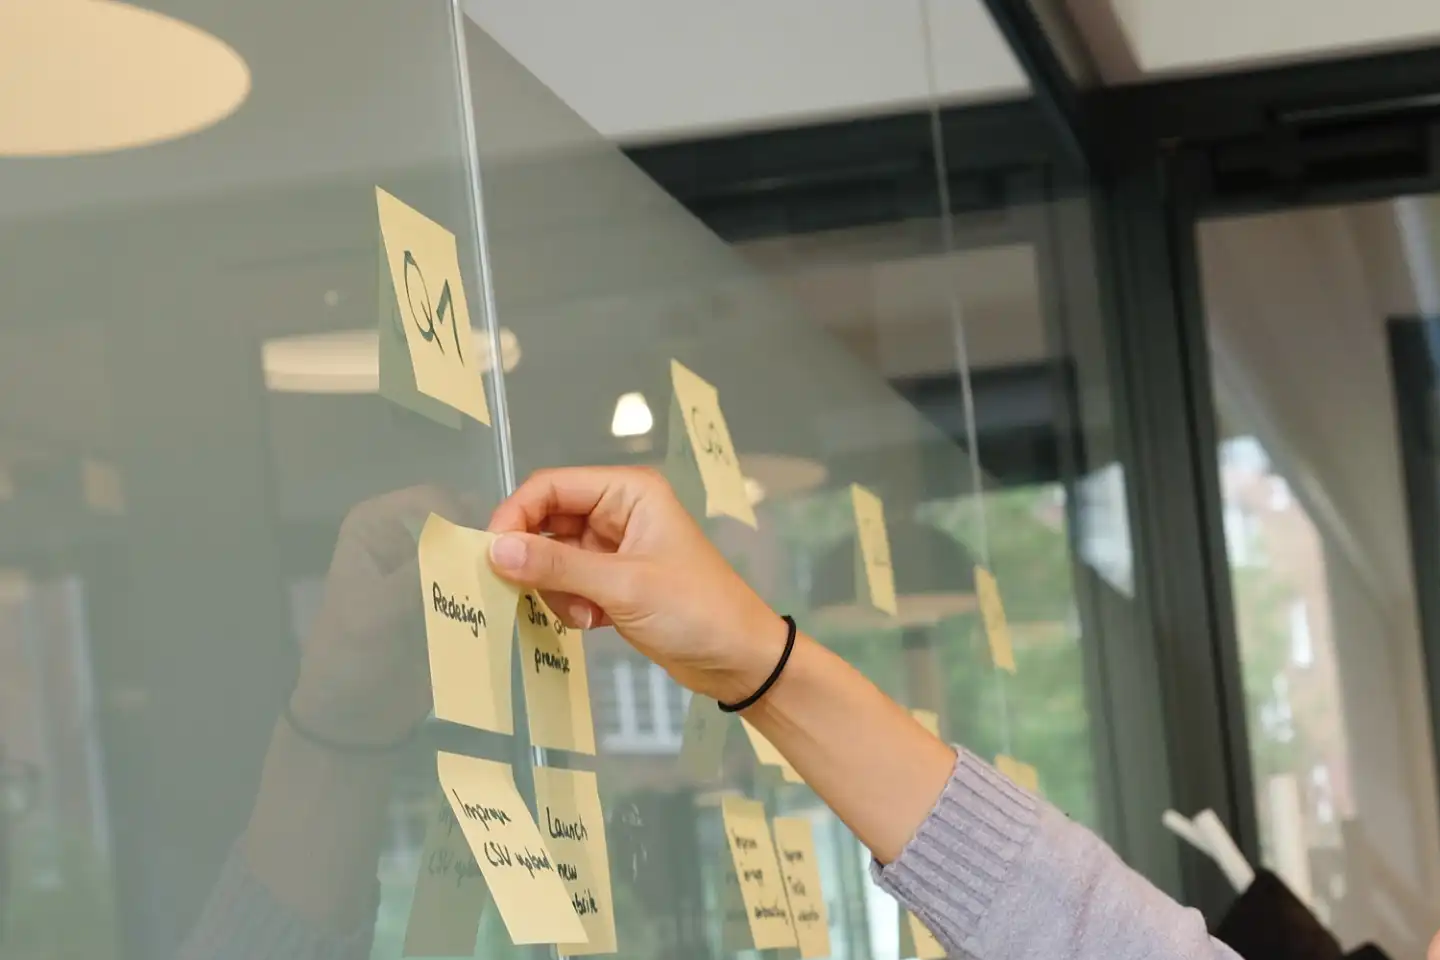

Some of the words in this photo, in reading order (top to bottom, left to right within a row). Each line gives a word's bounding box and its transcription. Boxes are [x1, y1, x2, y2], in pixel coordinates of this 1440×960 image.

[403, 250, 465, 368] Q1
[432, 580, 487, 638] Redesign
[452, 788, 512, 832] Improve
[546, 806, 588, 841] Launch
[484, 840, 513, 867] CSV
[514, 846, 554, 880] upload
[557, 863, 578, 882] new
[572, 888, 598, 915] bsite
